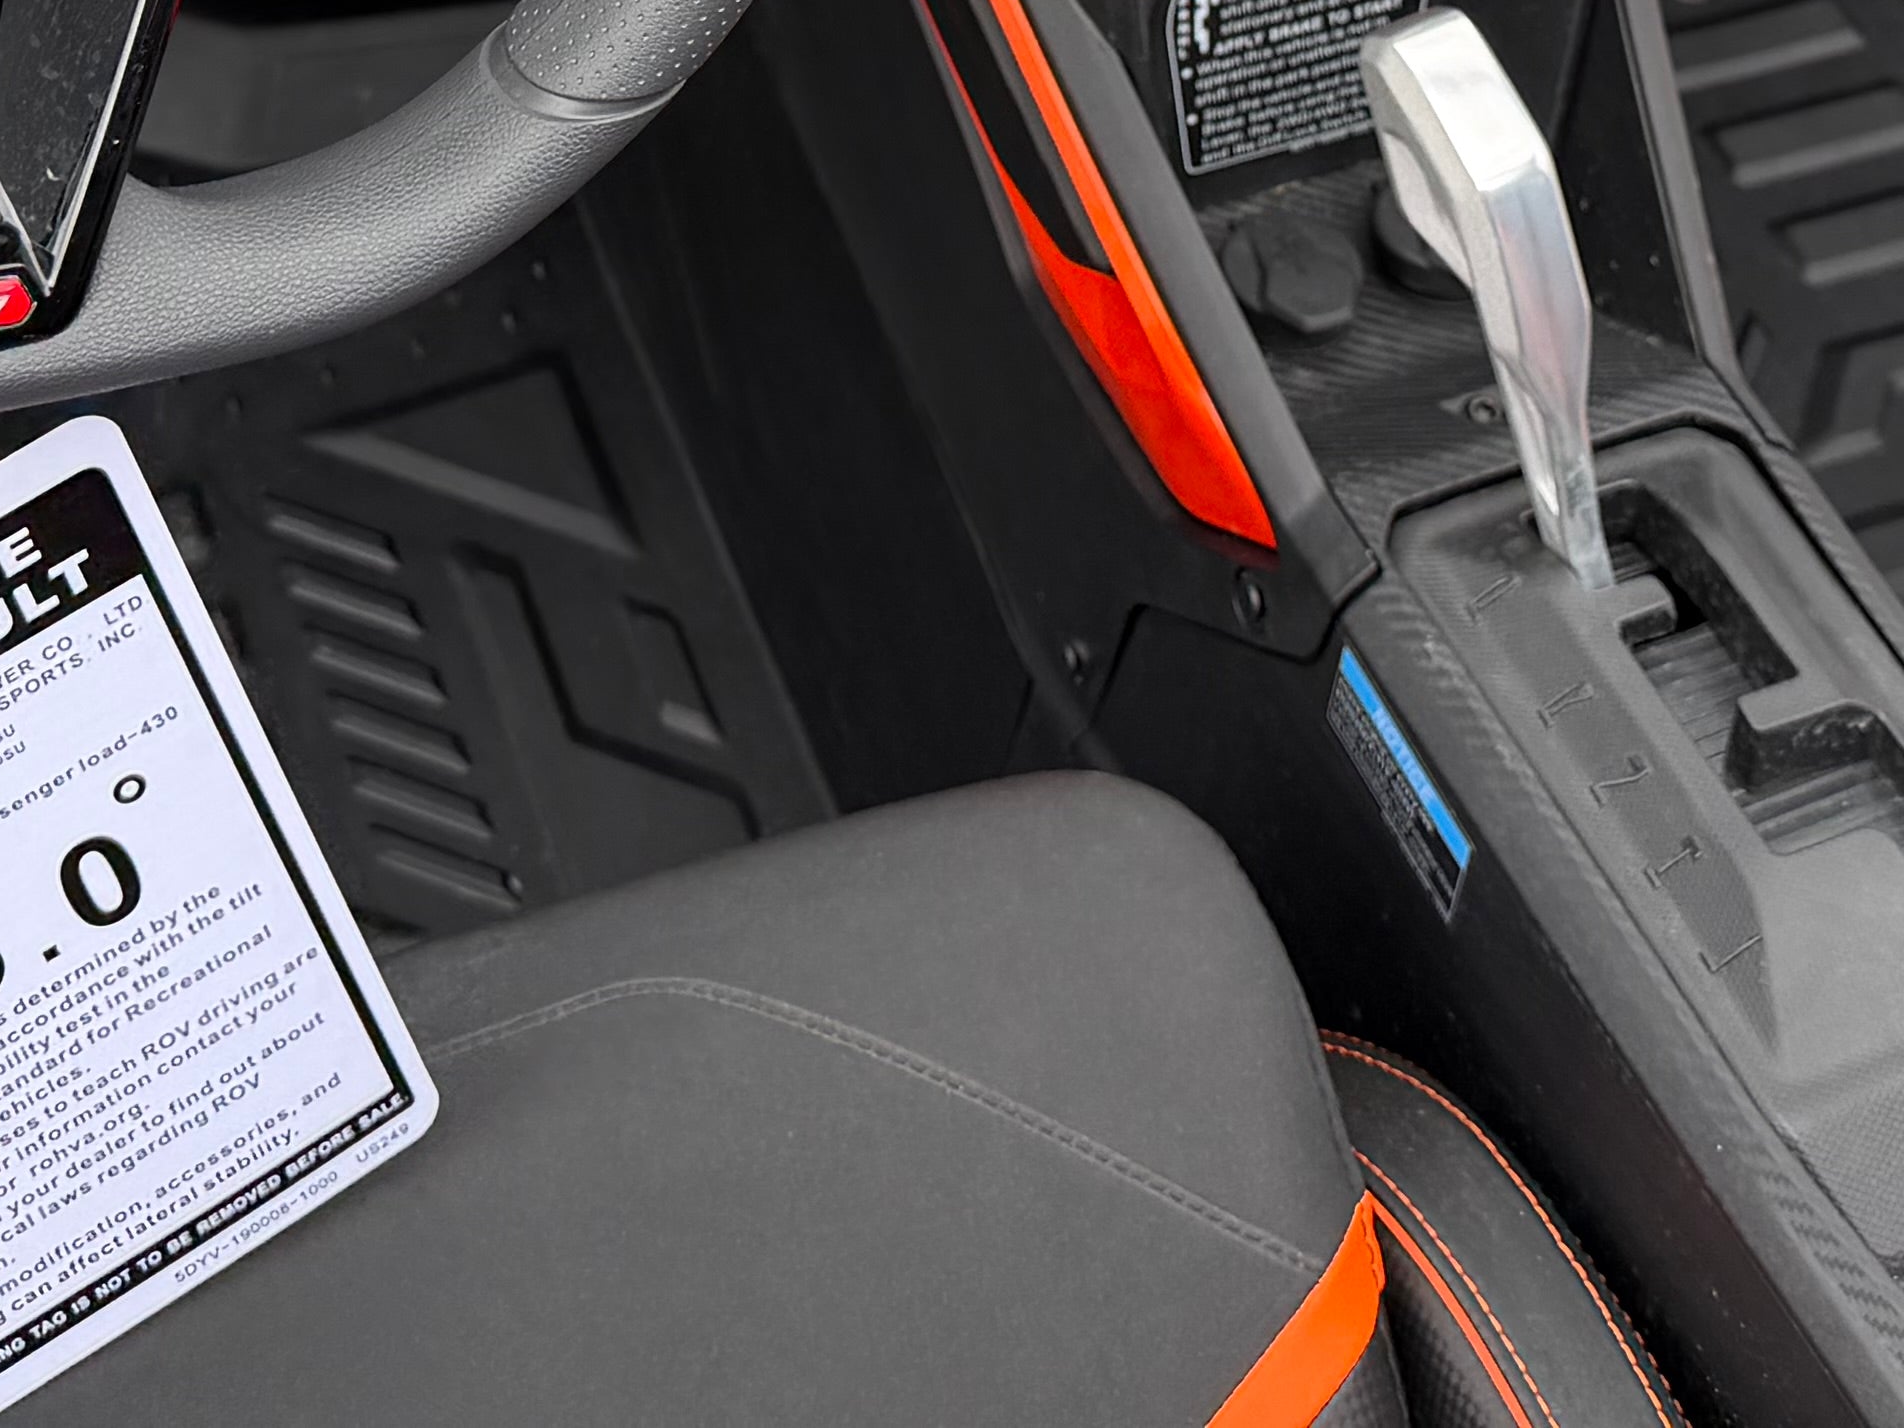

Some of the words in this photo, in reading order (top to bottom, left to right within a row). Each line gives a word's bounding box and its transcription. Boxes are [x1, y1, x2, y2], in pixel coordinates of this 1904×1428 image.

[77, 705, 178, 772] load-430
[11, 926, 146, 1015] determined
[148, 909, 177, 934] by
[182, 886, 220, 914] the
[85, 1016, 119, 1045] for
[123, 923, 272, 1022] Recreational
[132, 932, 184, 967] with
[186, 907, 225, 936] the
[228, 883, 262, 911] tilt
[42, 1099, 68, 1119] to
[71, 1057, 137, 1102] teach
[139, 1019, 190, 1061] ROV
[197, 971, 279, 1026] driving
[283, 946, 318, 975] are
[54, 1003, 103, 1039] test
[104, 990, 129, 1009] in
[131, 965, 169, 993] the
[5, 1174, 58, 1219] your
[64, 1128, 136, 1179] dealer
[140, 1113, 165, 1133] to
[167, 1078, 214, 1116] find
[218, 1054, 257, 1084] out
[260, 1011, 324, 1060] about
[14, 1073, 152, 1161] information
[156, 1015, 243, 1076] contact
[244, 981, 295, 1025] your
[154, 1108, 297, 1199] accessories,
[301, 1071, 341, 1106] and
[28, 1102, 150, 1178] rohva.org.
[37, 1181, 92, 1220] laws
[96, 1109, 209, 1184] regarding
[210, 1071, 259, 1113] ROV
[10, 1280, 53, 1311] can
[57, 1234, 124, 1283] affect
[124, 1185, 199, 1240] lateral
[202, 1127, 299, 1192] stability.
[28, 1309, 67, 1338] TAG
[70, 1294, 91, 1314] IS
[93, 1267, 131, 1300] NOT
[135, 1249, 162, 1271] TO
[165, 1229, 193, 1254] BE
[195, 1173, 281, 1235] REMOVED
[284, 1124, 355, 1178] BEFORE
